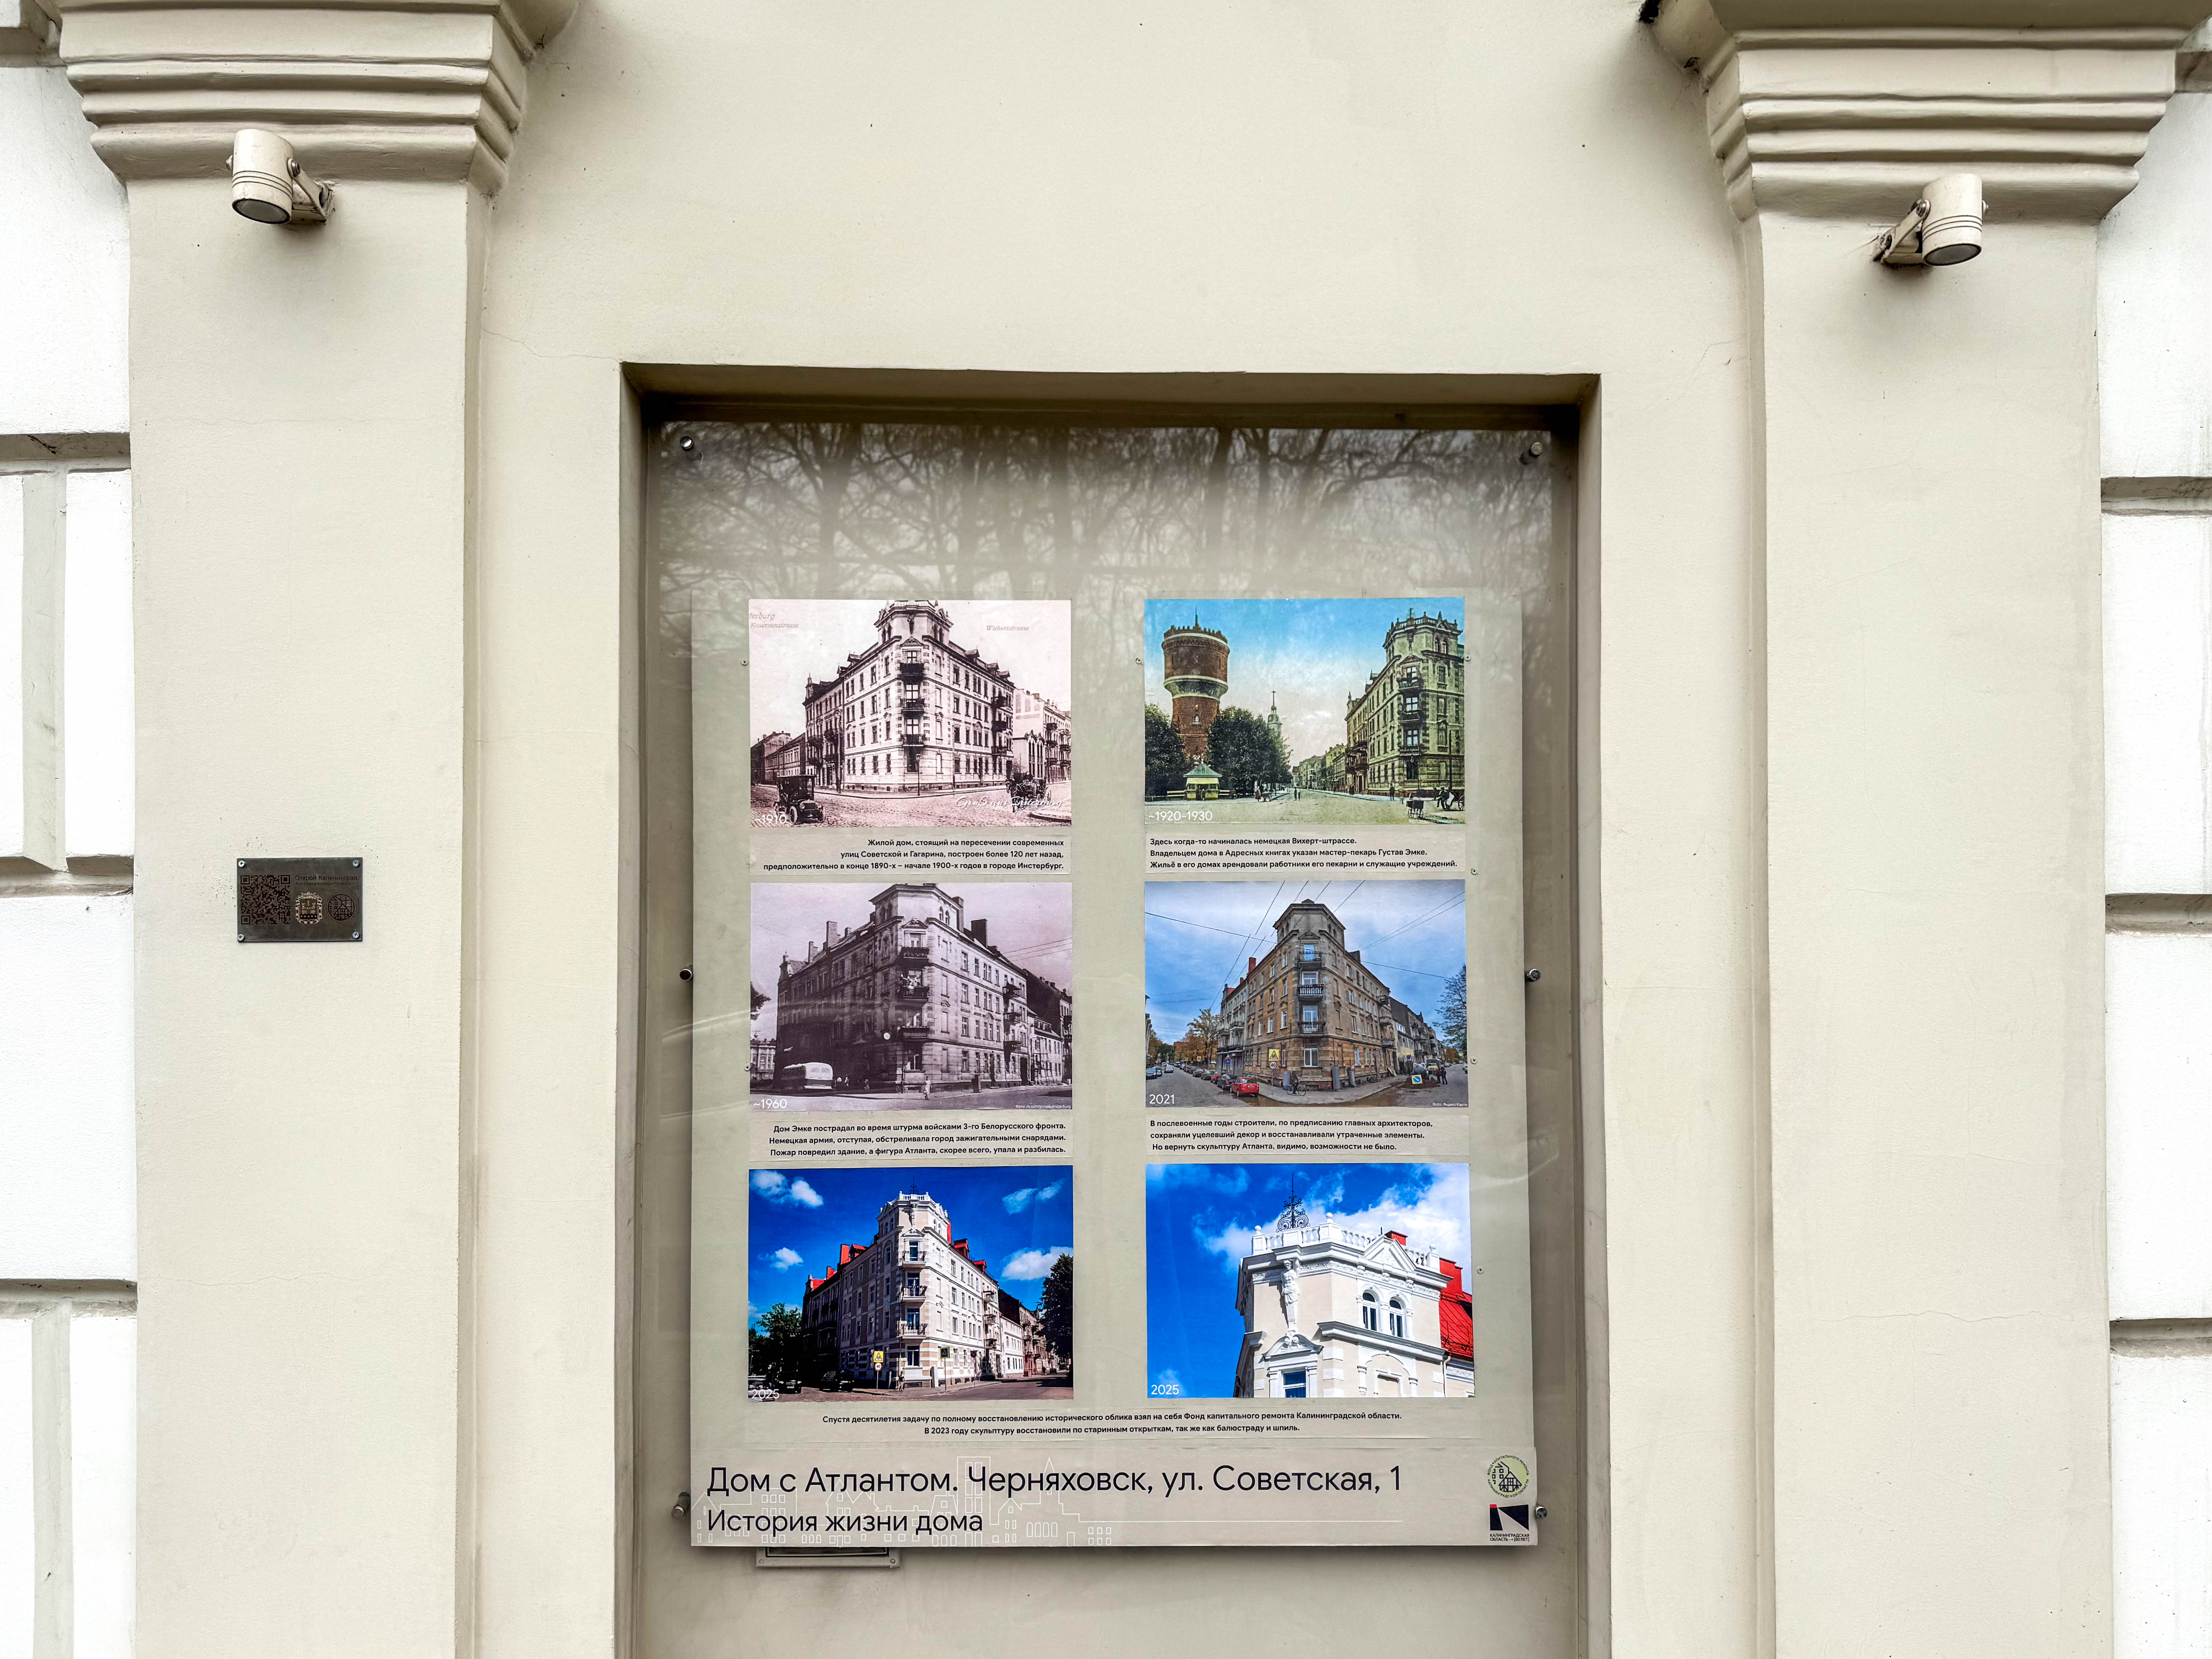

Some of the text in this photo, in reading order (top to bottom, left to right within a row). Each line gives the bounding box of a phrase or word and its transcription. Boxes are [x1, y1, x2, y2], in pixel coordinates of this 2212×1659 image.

[955, 796, 988, 809] Gruß
[754, 814, 787, 824] ~1910
[1148, 810, 1213, 821] ~1920-1930
[1150, 838, 1173, 846] Здесь
[1292, 837, 1357, 846] Вихерт-штрассе.
[910, 850, 946, 859] Гагарина,
[1225, 849, 1264, 858] Адресных
[1378, 849, 1404, 857] Густав
[1017, 862, 1064, 871] Инстербург.
[1269, 860, 1310, 869] работники
[1407, 860, 1457, 868] учреждений.
[753, 1098, 787, 1109] ~1960
[1149, 1094, 1175, 1104] 2021
[773, 1125, 790, 1134] Дом
[981, 1123, 1034, 1131] Белорусского
[1035, 1122, 1066, 1131] фронта.
[875, 1135, 930, 1144] обстреливала
[1192, 1131, 1235, 1140] уцелевший
[770, 1149, 796, 1157] Пожар
[875, 1147, 904, 1156] фигура
[1024, 1146, 1066, 1155] разбилась.
[751, 1388, 780, 1399] 2025
[1151, 1384, 1179, 1395] 2025
[822, 1415, 850, 1425] Спустя
[1183, 1412, 1206, 1421] Фонд
[1296, 1411, 1366, 1420] Калининградской
[1492, 1455, 1520, 1465] КАПИТАЛЬНОГО
[1519, 1459, 1529, 1476] РЕМОНТА
[707, 1464, 1400, 1498] Дом с Атлантом. Черняховск, ул. Советская, 1
[708, 1509, 983, 1538] История жизни дома
